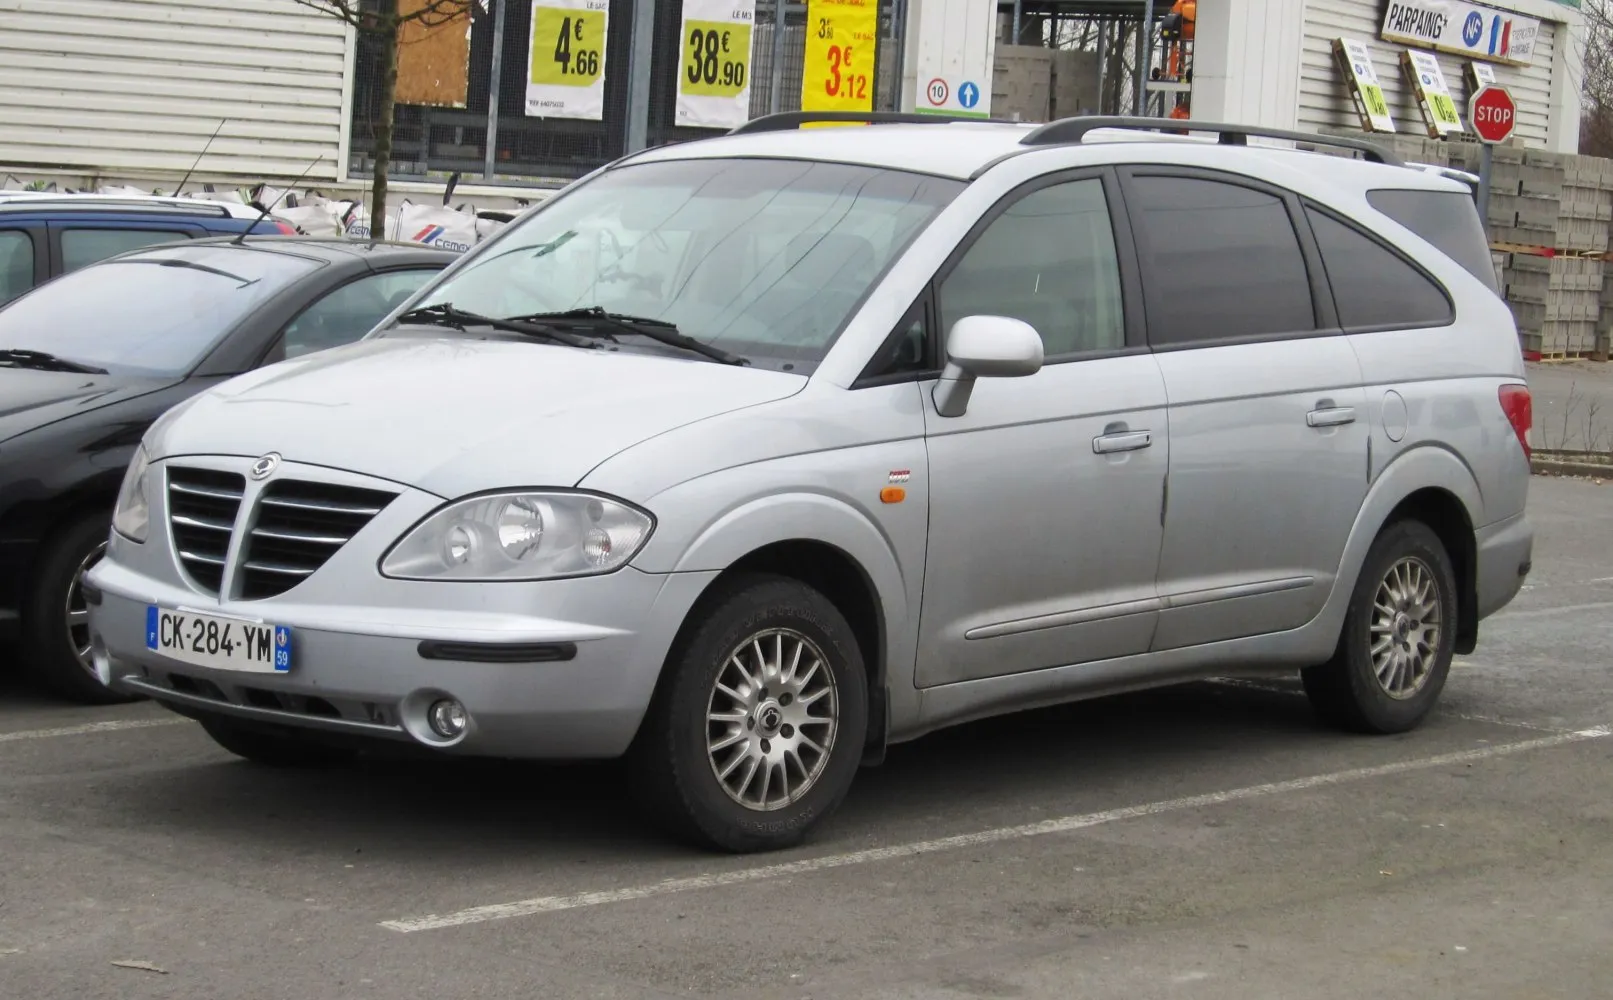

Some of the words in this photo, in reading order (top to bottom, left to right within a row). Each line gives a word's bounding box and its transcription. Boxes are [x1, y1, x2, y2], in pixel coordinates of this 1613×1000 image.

[732, 11, 740, 19] LE
[741, 11, 752, 20] M3
[932, 85, 944, 98] 10
[1477, 105, 1511, 124] STOP
[160, 613, 271, 662] CK-284-YM
[277, 650, 288, 666] 59
